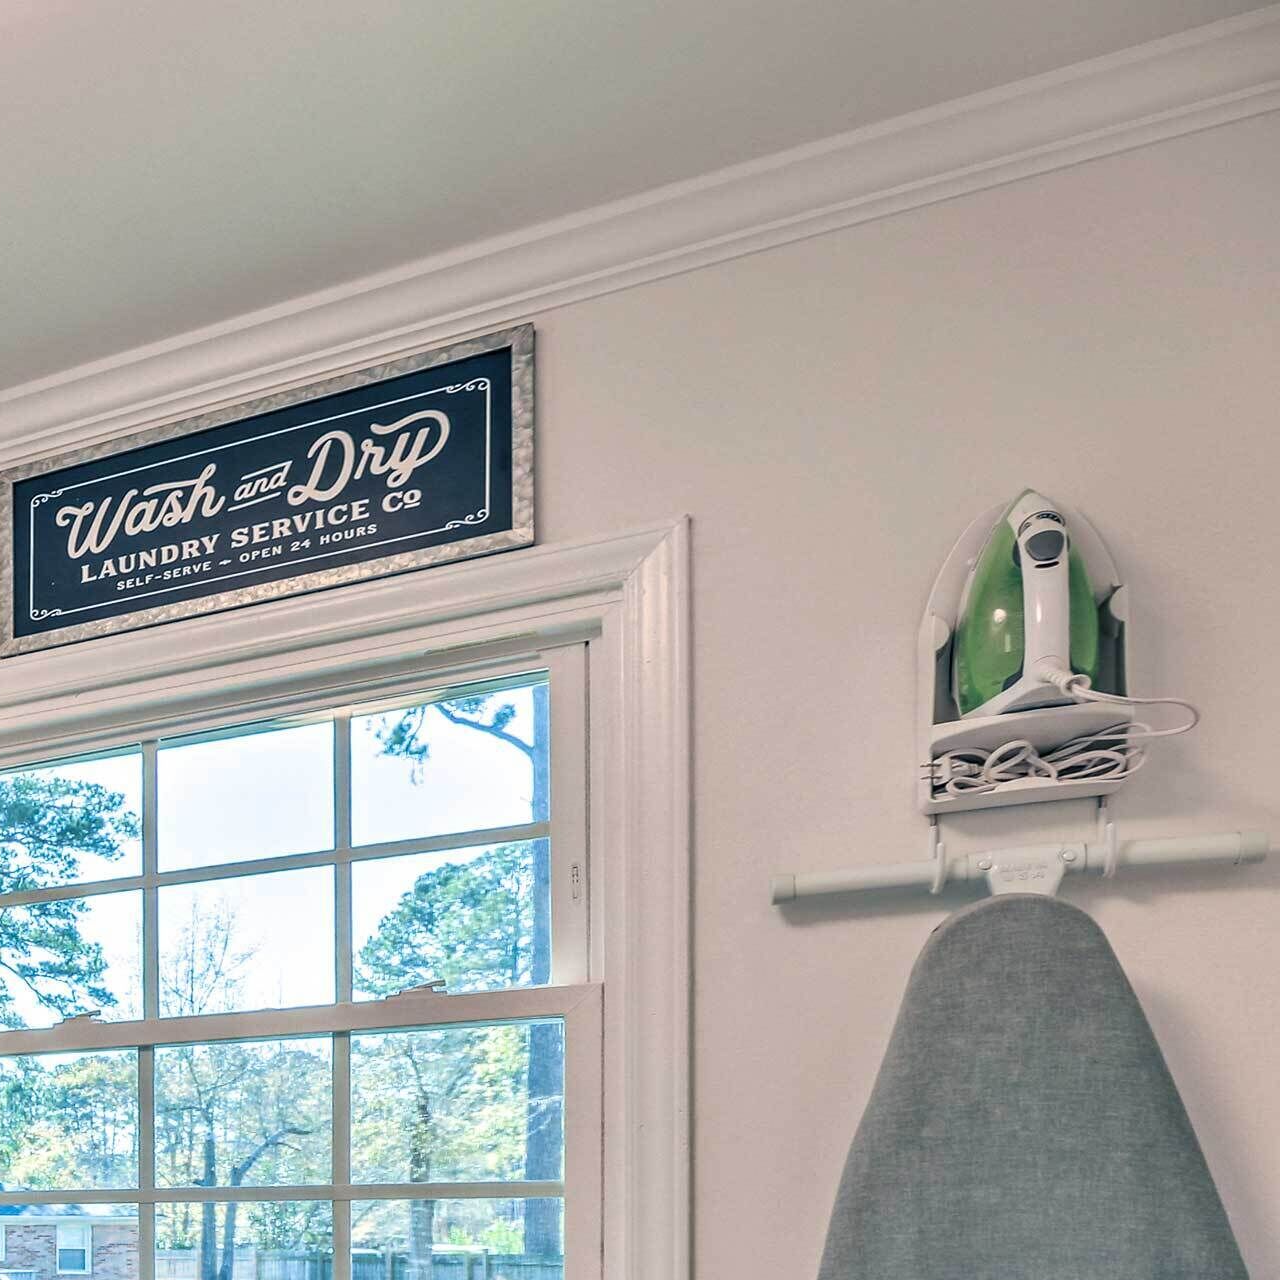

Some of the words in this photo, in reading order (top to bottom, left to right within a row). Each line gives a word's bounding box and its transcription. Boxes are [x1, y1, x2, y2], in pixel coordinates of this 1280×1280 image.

[56, 463, 226, 559] Wash
[234, 461, 292, 502] and
[287, 409, 450, 502] Dry
[80, 533, 219, 583] LAUNDRY
[231, 499, 370, 549] SERVICE
[116, 561, 212, 591] SELF-SERVE
[239, 544, 282, 563] OPEN
[290, 537, 312, 552] 24
[319, 523, 378, 545] HOURS
